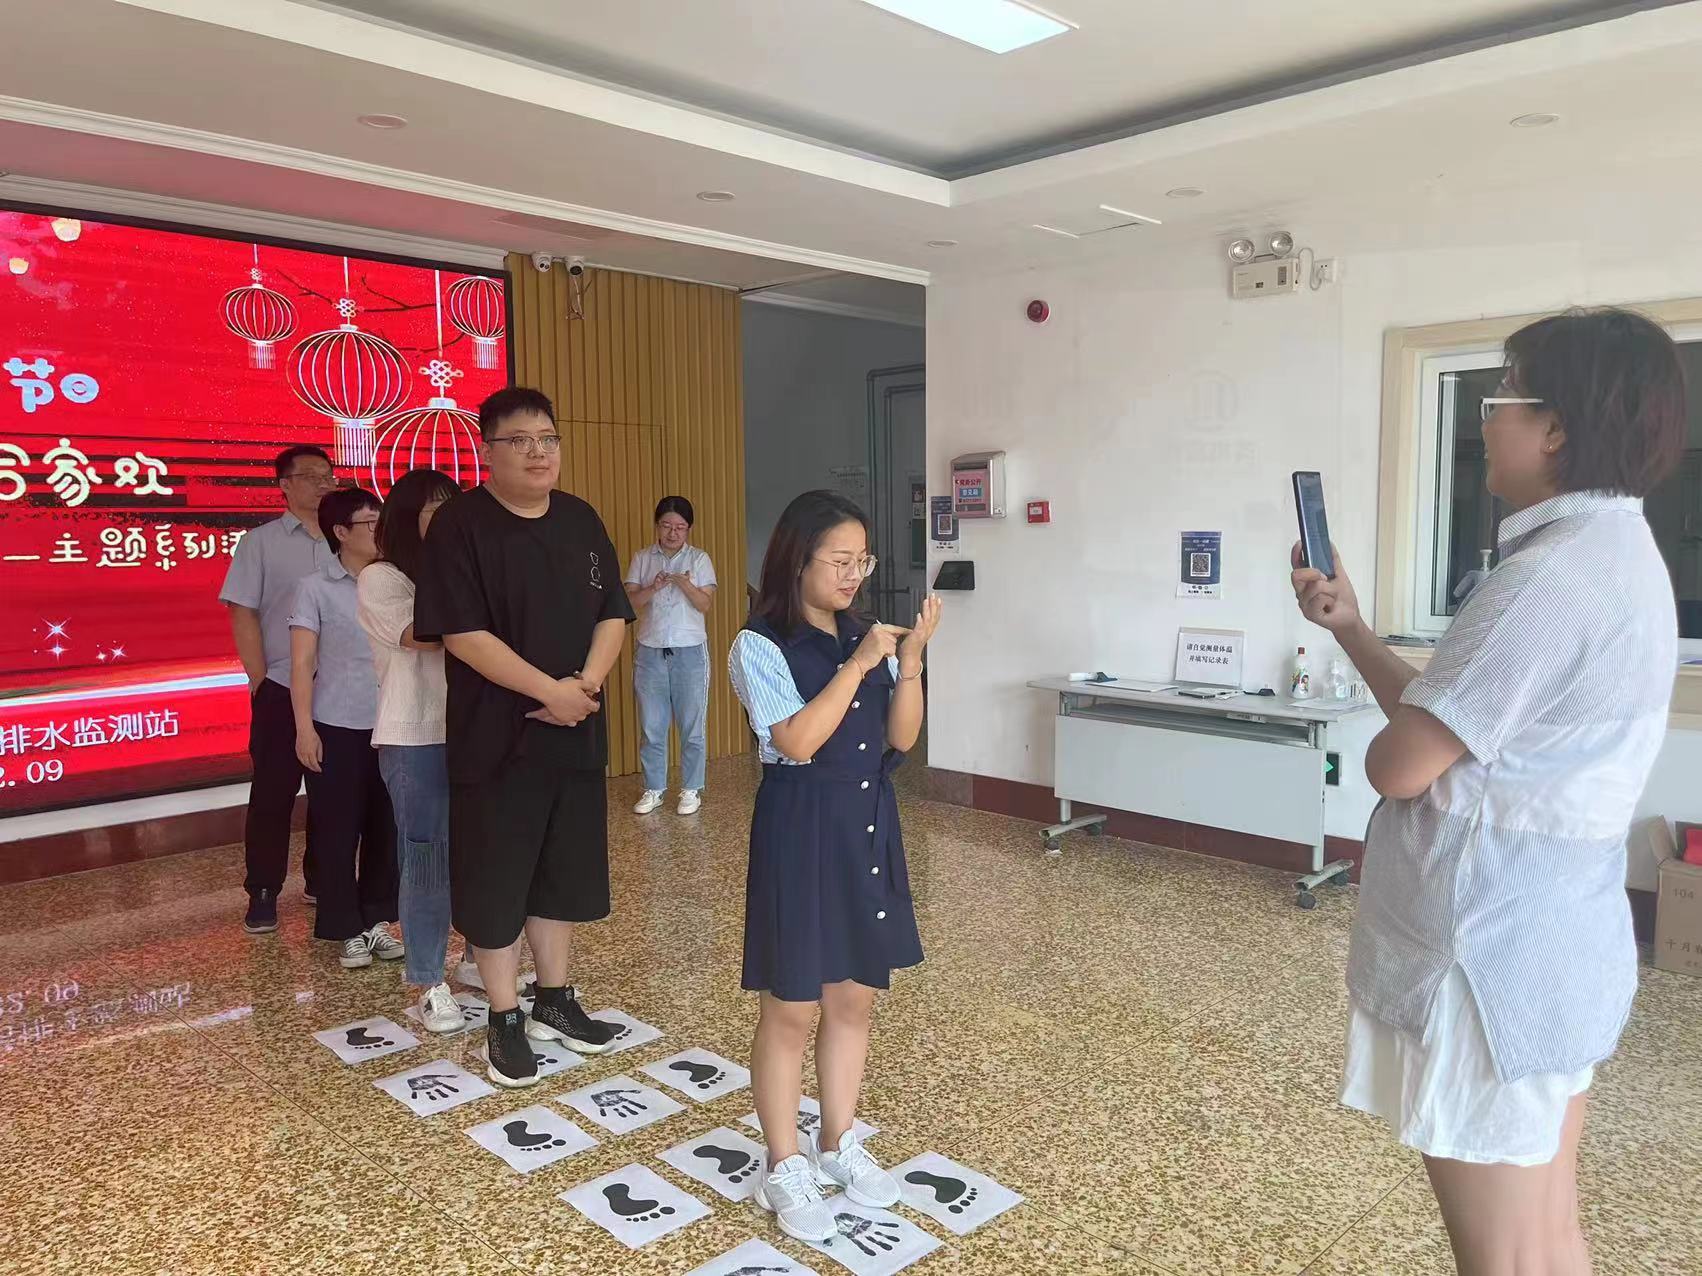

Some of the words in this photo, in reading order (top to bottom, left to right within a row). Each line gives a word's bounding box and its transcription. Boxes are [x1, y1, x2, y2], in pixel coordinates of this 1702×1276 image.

[3, 357, 100, 413] 节日
[0, 708, 179, 756] 排水监测站
